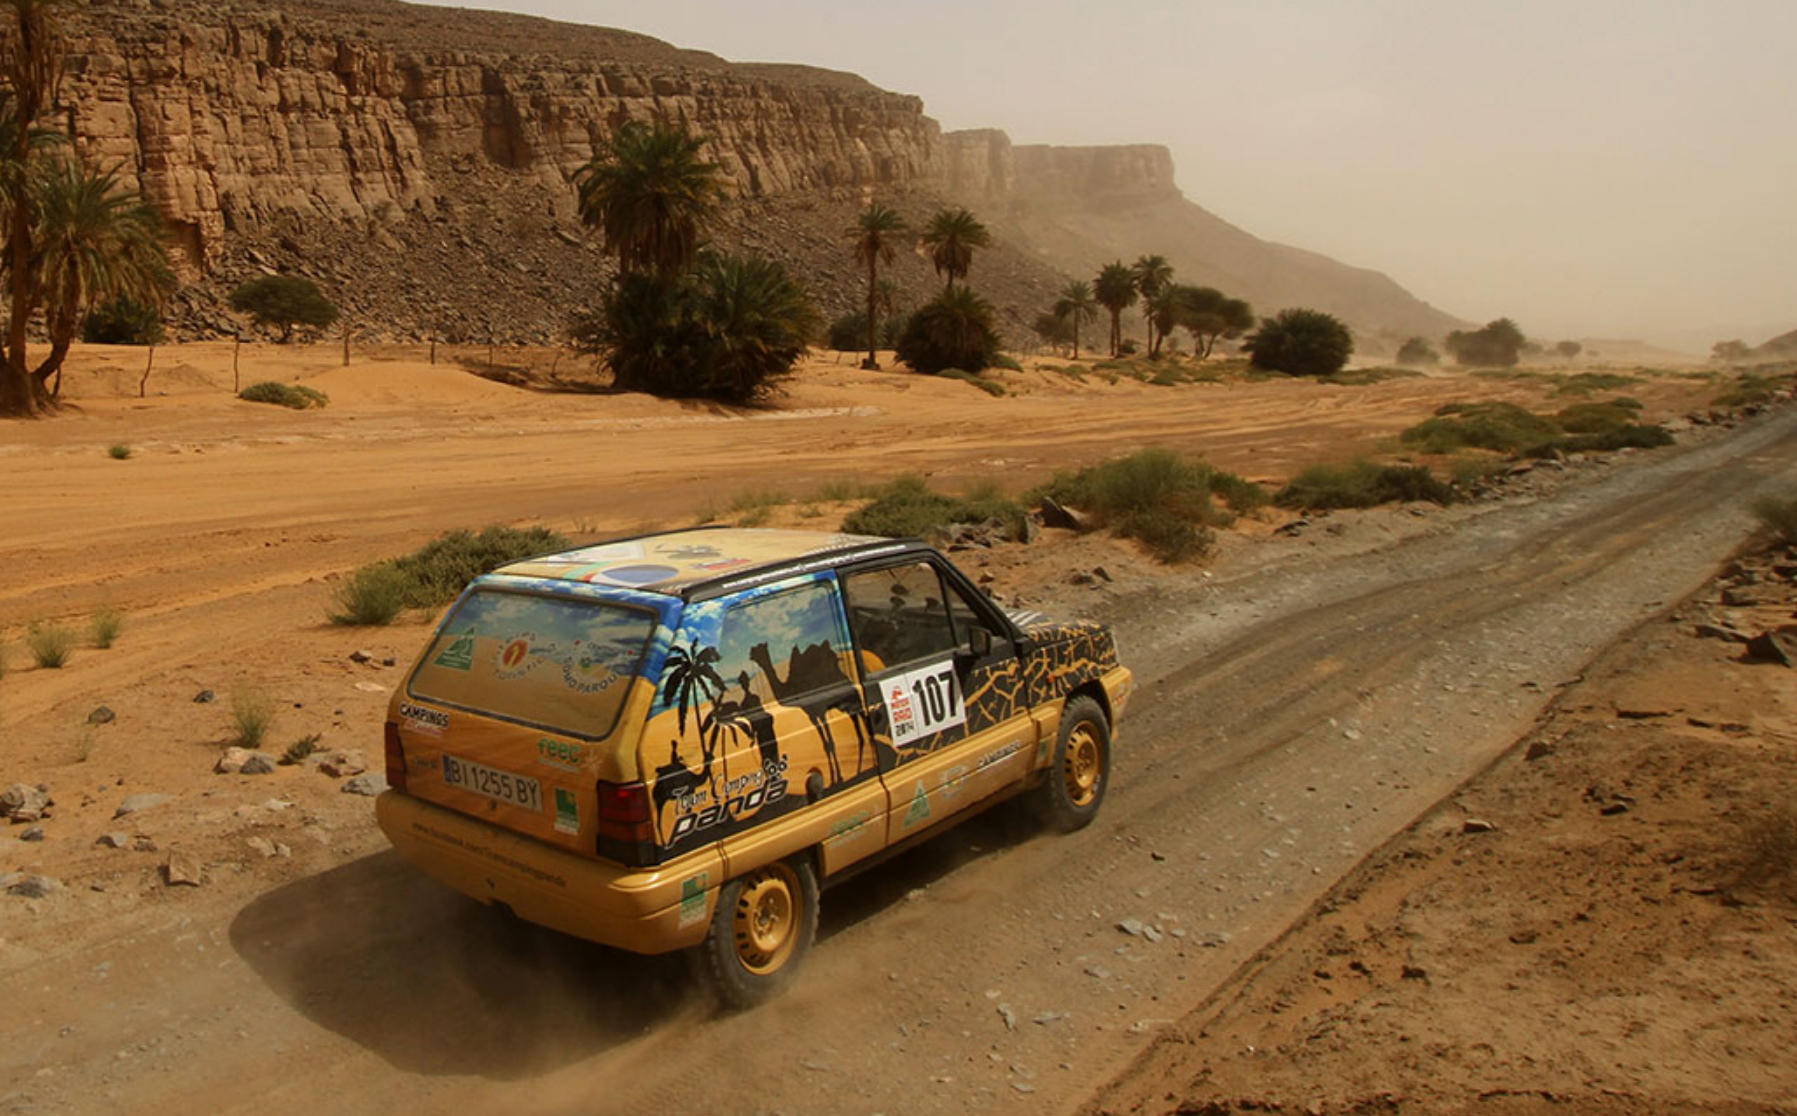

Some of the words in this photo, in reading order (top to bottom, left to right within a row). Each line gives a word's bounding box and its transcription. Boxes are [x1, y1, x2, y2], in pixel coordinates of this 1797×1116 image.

[400, 702, 449, 728] CAMPINGS
[912, 670, 956, 726] 107
[664, 779, 788, 850] panda
